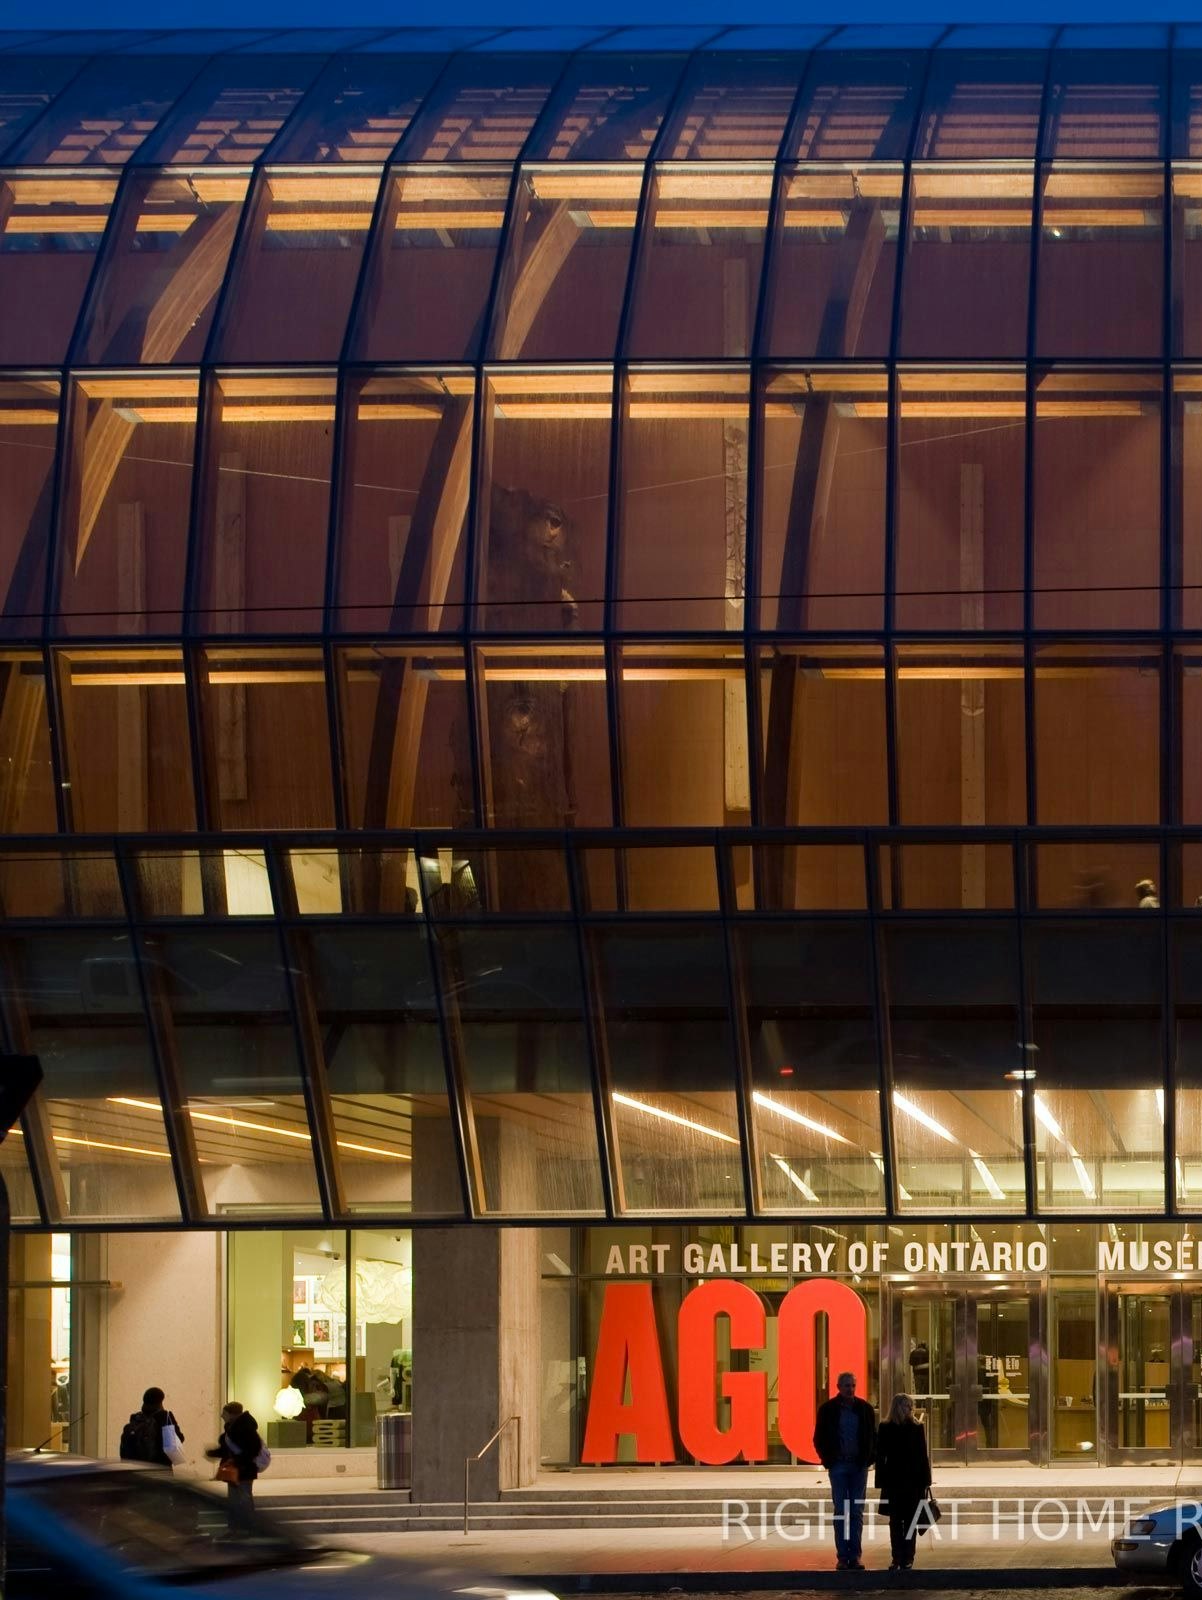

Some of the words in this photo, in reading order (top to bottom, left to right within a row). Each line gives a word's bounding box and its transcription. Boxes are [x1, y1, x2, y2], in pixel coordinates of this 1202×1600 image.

[605, 1244, 671, 1274] ART
[683, 1243, 836, 1274] GALLERY
[847, 1242, 890, 1273] OF
[904, 1241, 1048, 1272] ONTARIO
[582, 1278, 867, 1465] AGO
